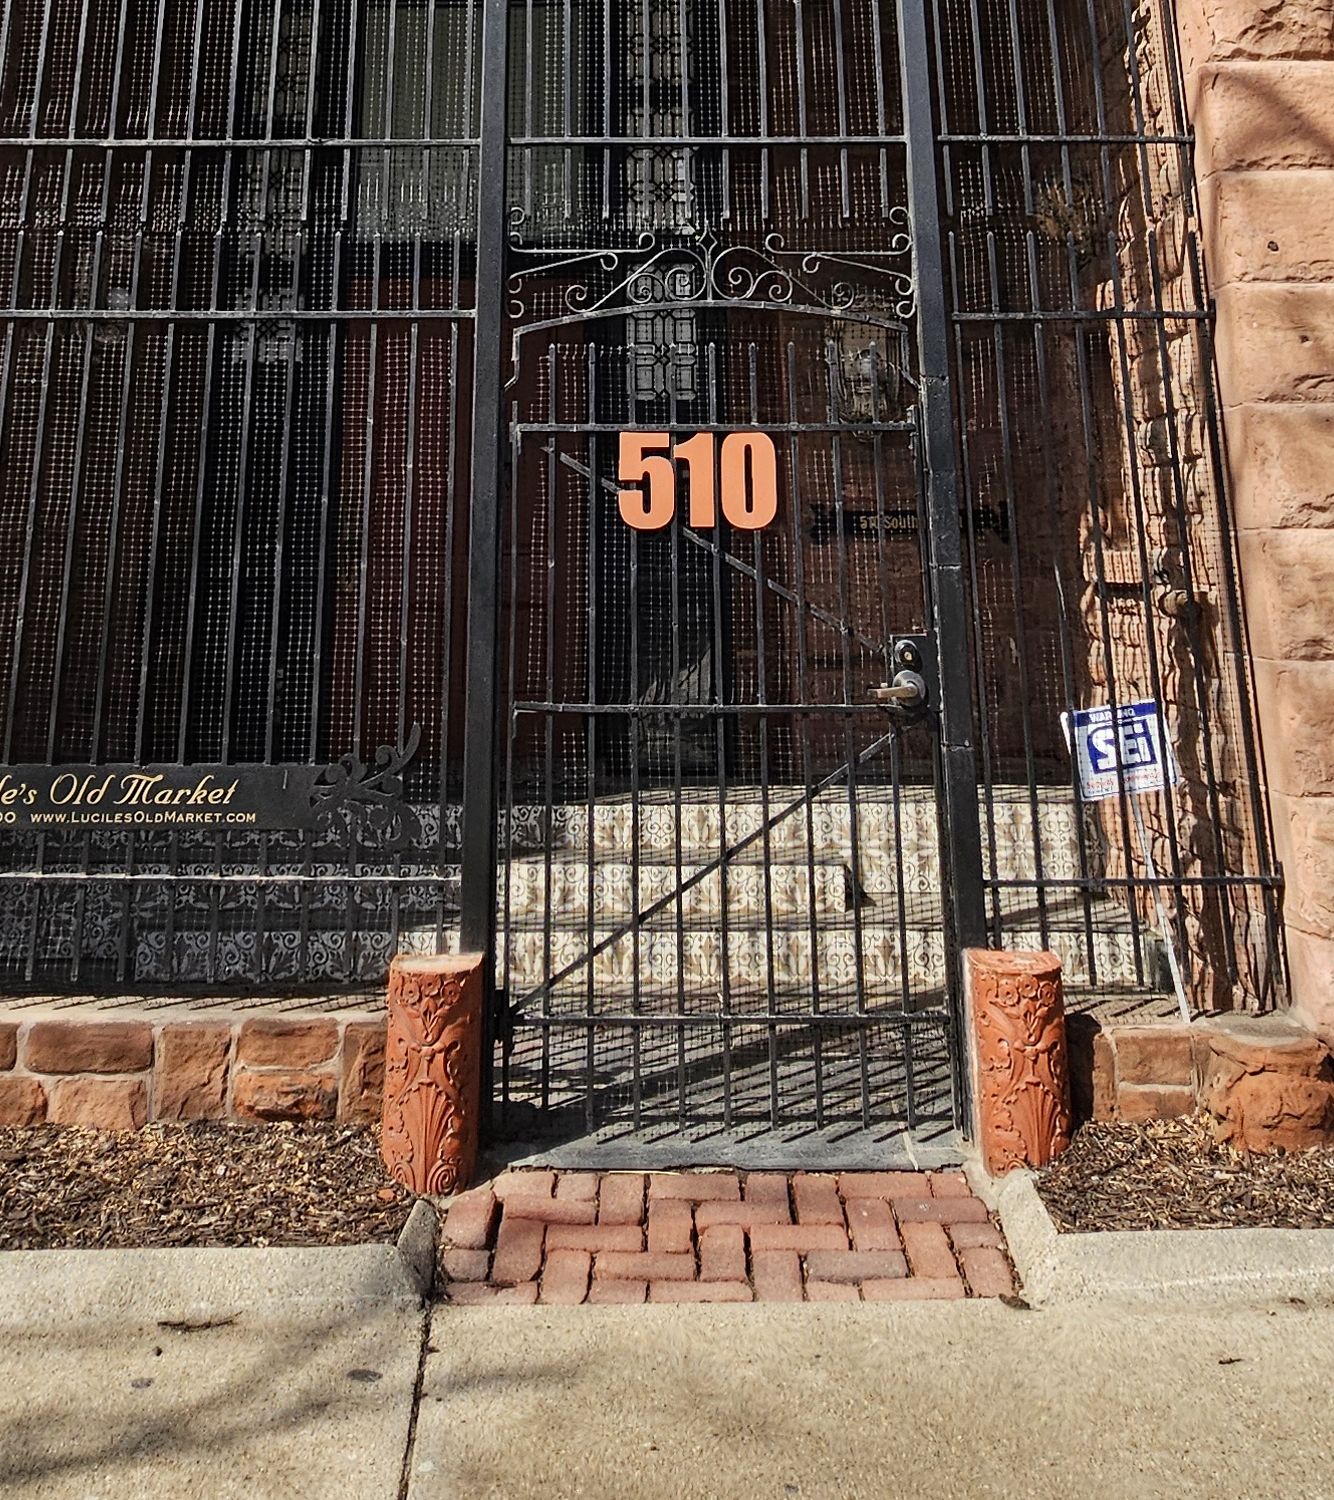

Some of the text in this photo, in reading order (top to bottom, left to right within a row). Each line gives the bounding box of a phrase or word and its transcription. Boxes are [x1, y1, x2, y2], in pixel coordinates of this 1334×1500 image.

[618, 431, 778, 529] 510
[1088, 707, 1136, 723] WARING
[49, 773, 116, 805] Old
[113, 773, 239, 805] Market
